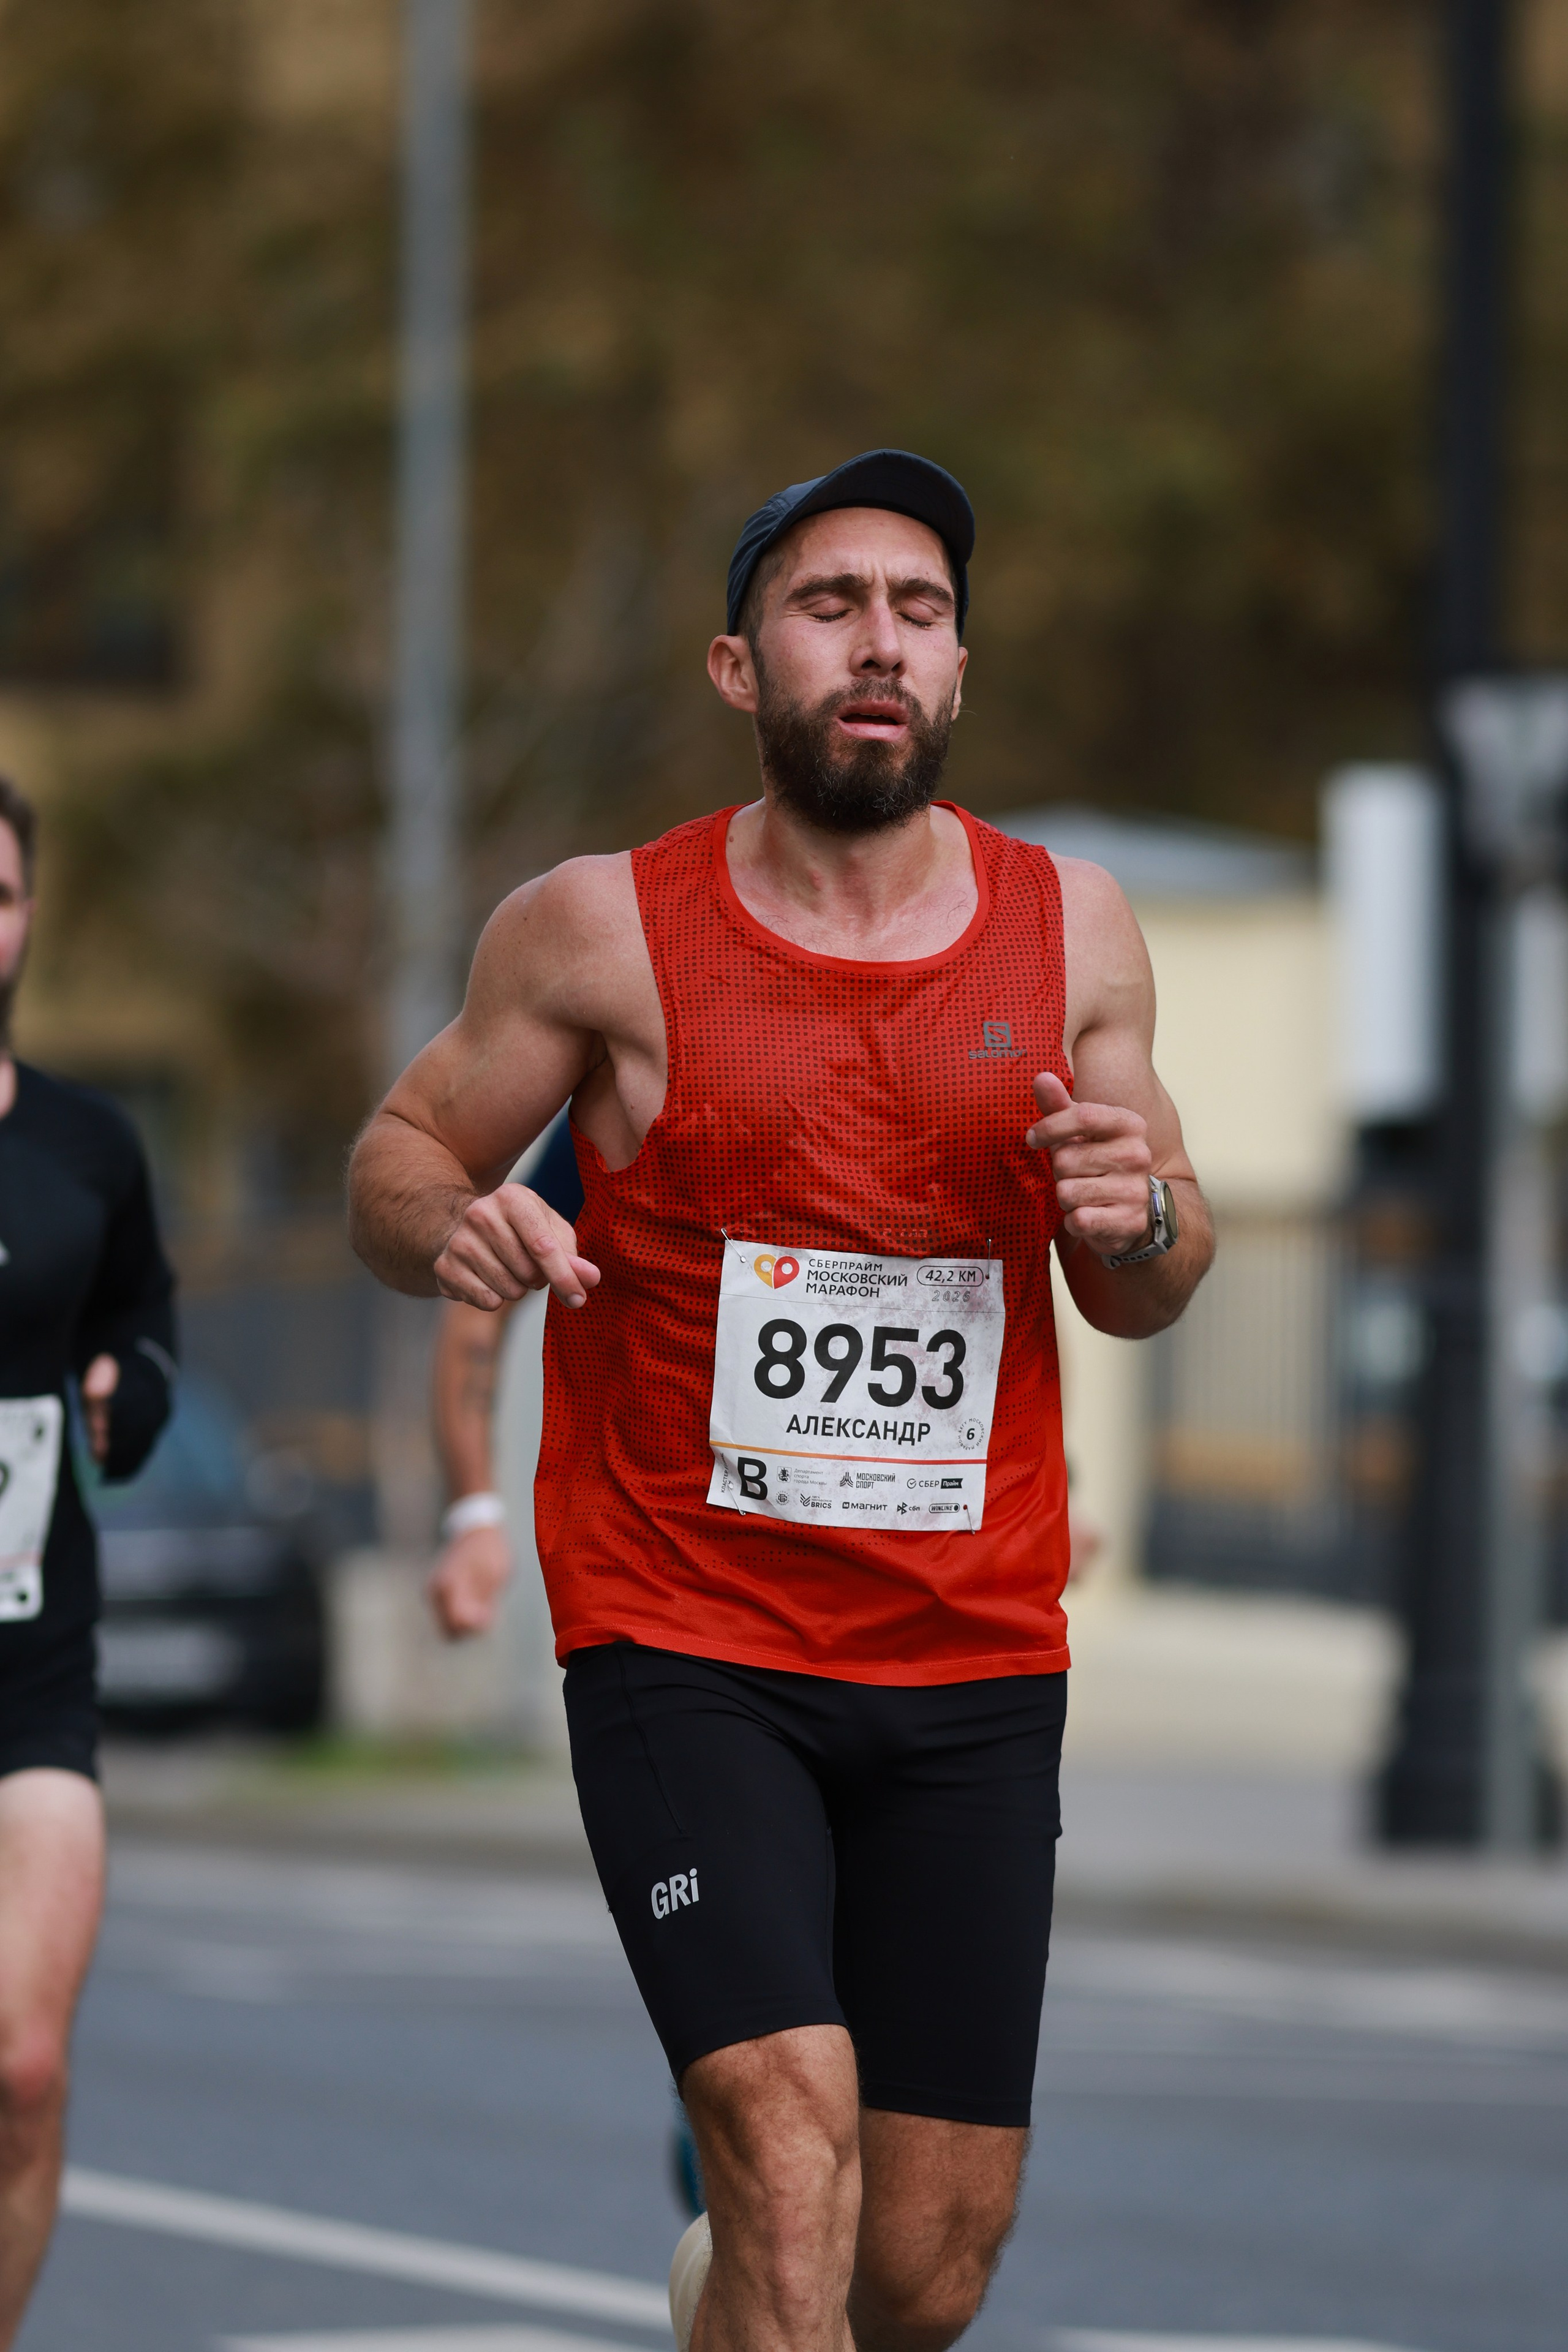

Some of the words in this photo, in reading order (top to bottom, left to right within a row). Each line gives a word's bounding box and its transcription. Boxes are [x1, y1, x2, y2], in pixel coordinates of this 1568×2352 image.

[969, 1049, 1027, 1059] salomon
[809, 1259, 883, 1272] СБЕРПРАЙМ
[807, 1270, 908, 1286] МОСКОВСКИЙ
[925, 1270, 953, 1283] 42,2
[959, 1271, 976, 1282] КМ
[805, 1284, 880, 1298] МАРАФОН
[932, 1290, 970, 1302] 2026
[753, 1318, 967, 1409] 8953
[786, 1415, 930, 1446] АЛЕКСАНДР
[967, 1428, 974, 1440] 6
[737, 1457, 767, 1501] B
[857, 1472, 895, 1482] МОСКОВСКИЙ
[651, 1868, 699, 1919] GRi
